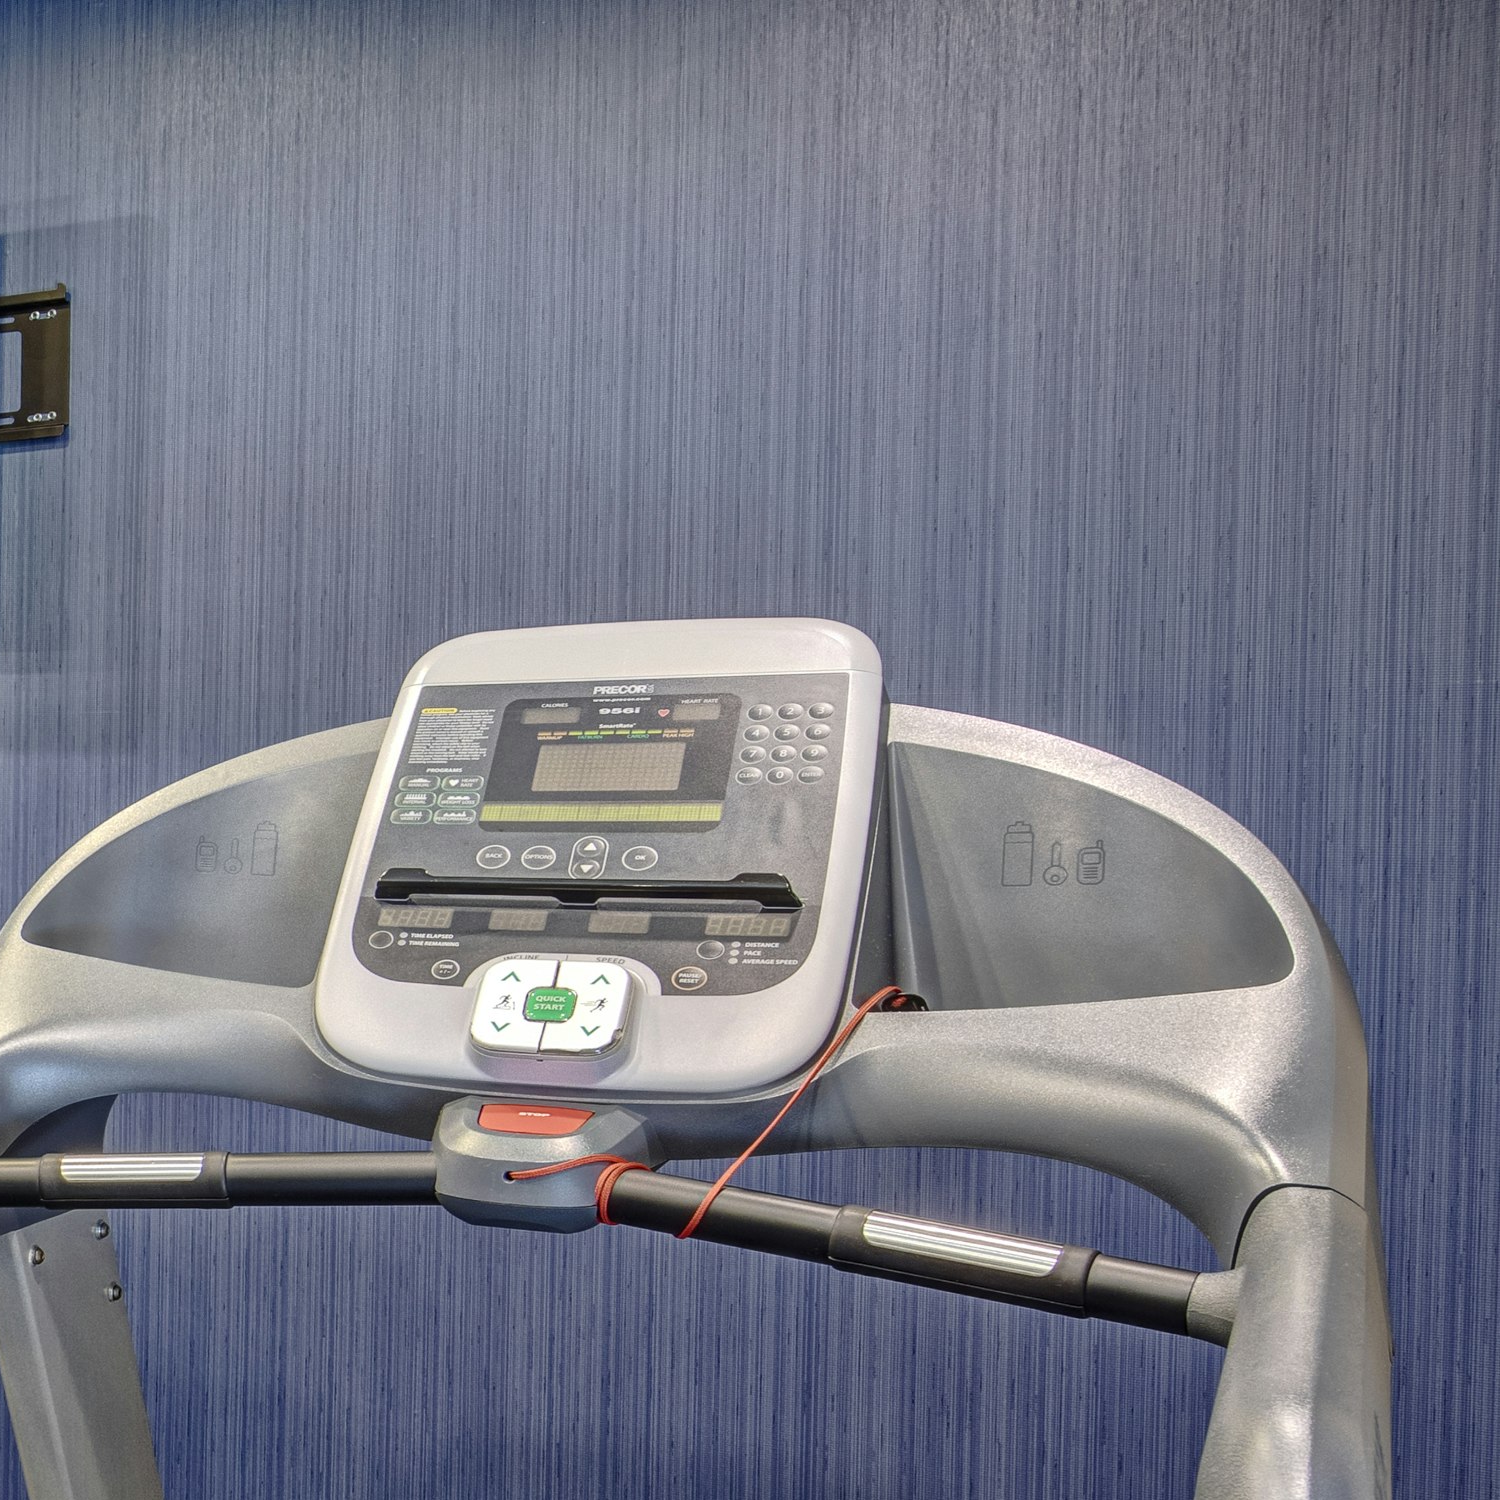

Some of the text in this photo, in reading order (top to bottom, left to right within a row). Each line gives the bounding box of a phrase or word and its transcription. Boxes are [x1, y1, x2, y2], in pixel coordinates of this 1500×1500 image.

[592, 684, 647, 695] PRECOR
[786, 707, 794, 715] 2
[817, 706, 825, 715] 3
[751, 727, 822, 737] 4 5 6
[749, 748, 819, 758] 7 8 9
[775, 771, 784, 779] 0
[596, 956, 626, 965] SPEED
[535, 995, 567, 1003] QUICK
[533, 1003, 565, 1011] START
